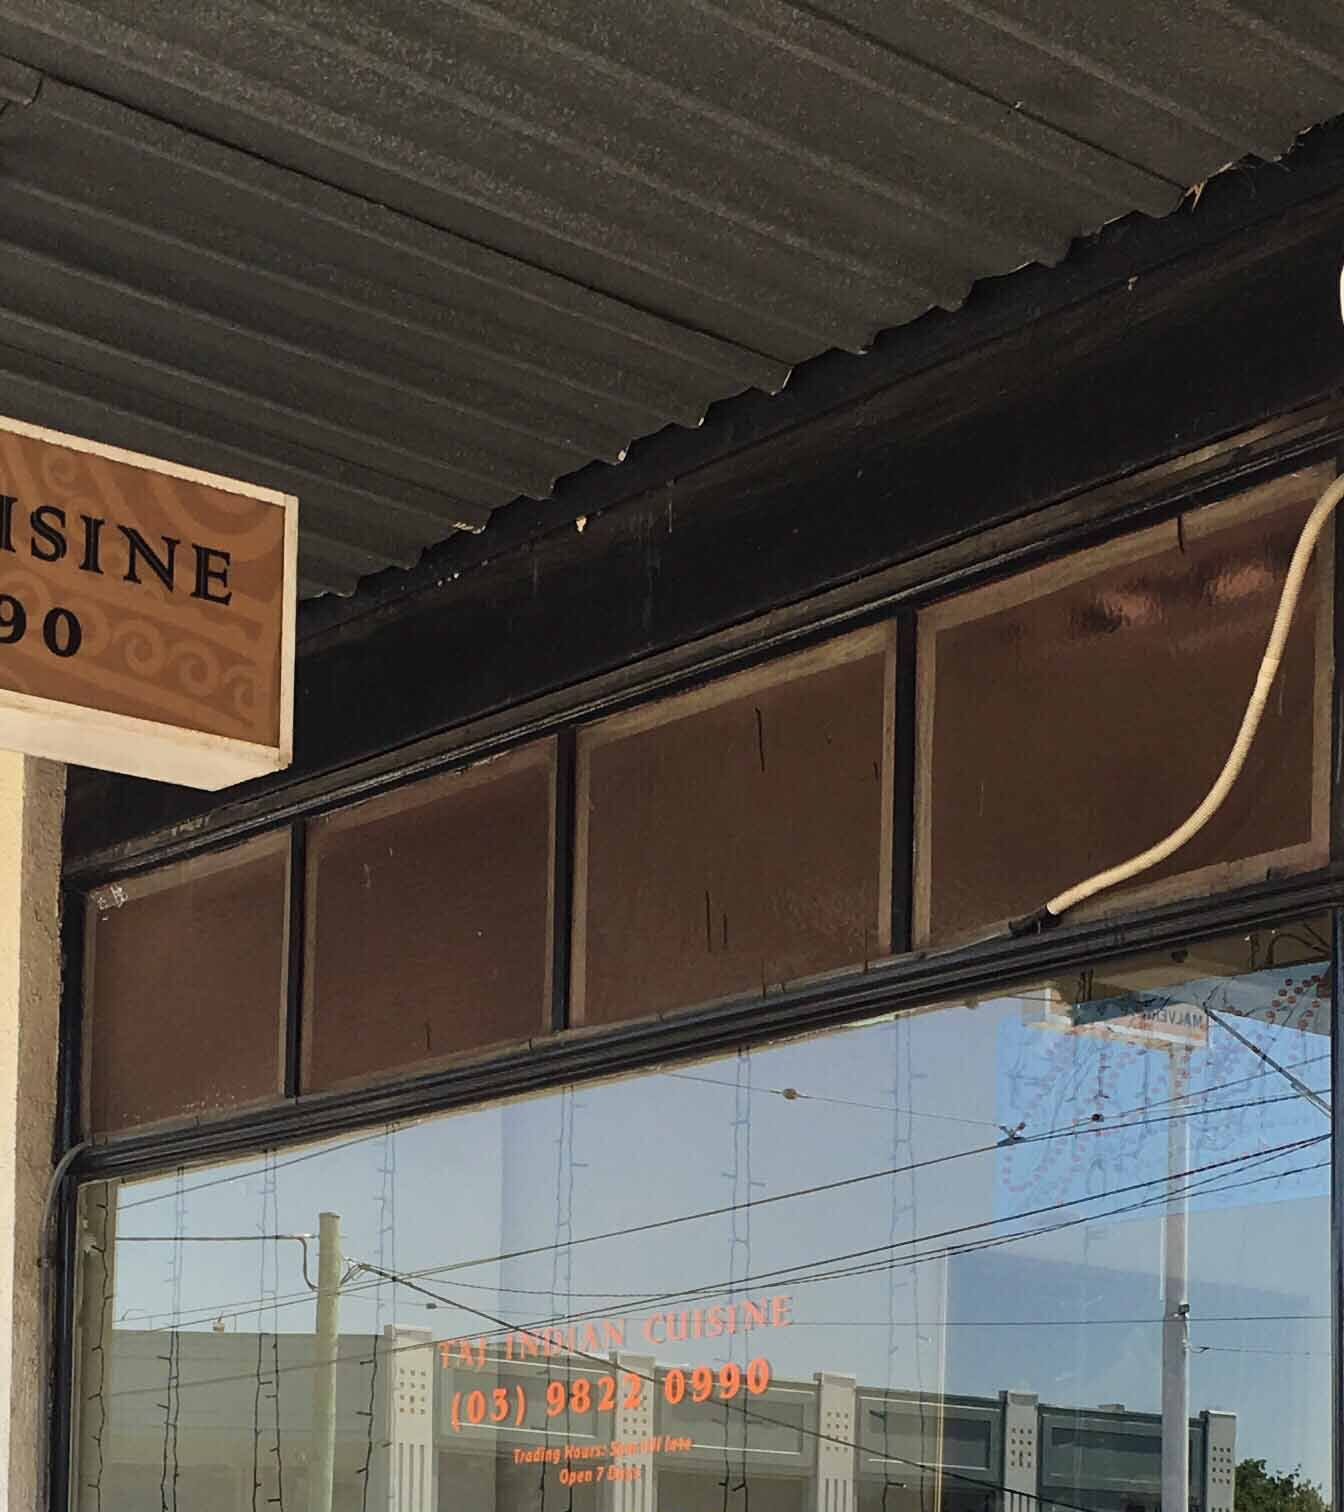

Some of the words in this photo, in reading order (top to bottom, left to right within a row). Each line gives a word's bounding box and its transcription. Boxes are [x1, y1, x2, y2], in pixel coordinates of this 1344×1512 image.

[440, 1334, 489, 1370] TAJ
[505, 1317, 626, 1361] INDIAN
[643, 1295, 793, 1345] CUISINE
[450, 1385, 526, 1432] (03)
[546, 1374, 643, 1417] 9822
[664, 1357, 773, 1405] 0990
[513, 1447, 561, 1464] Trading
[559, 1468, 593, 1486] Open
[596, 1466, 605, 1482] 7
